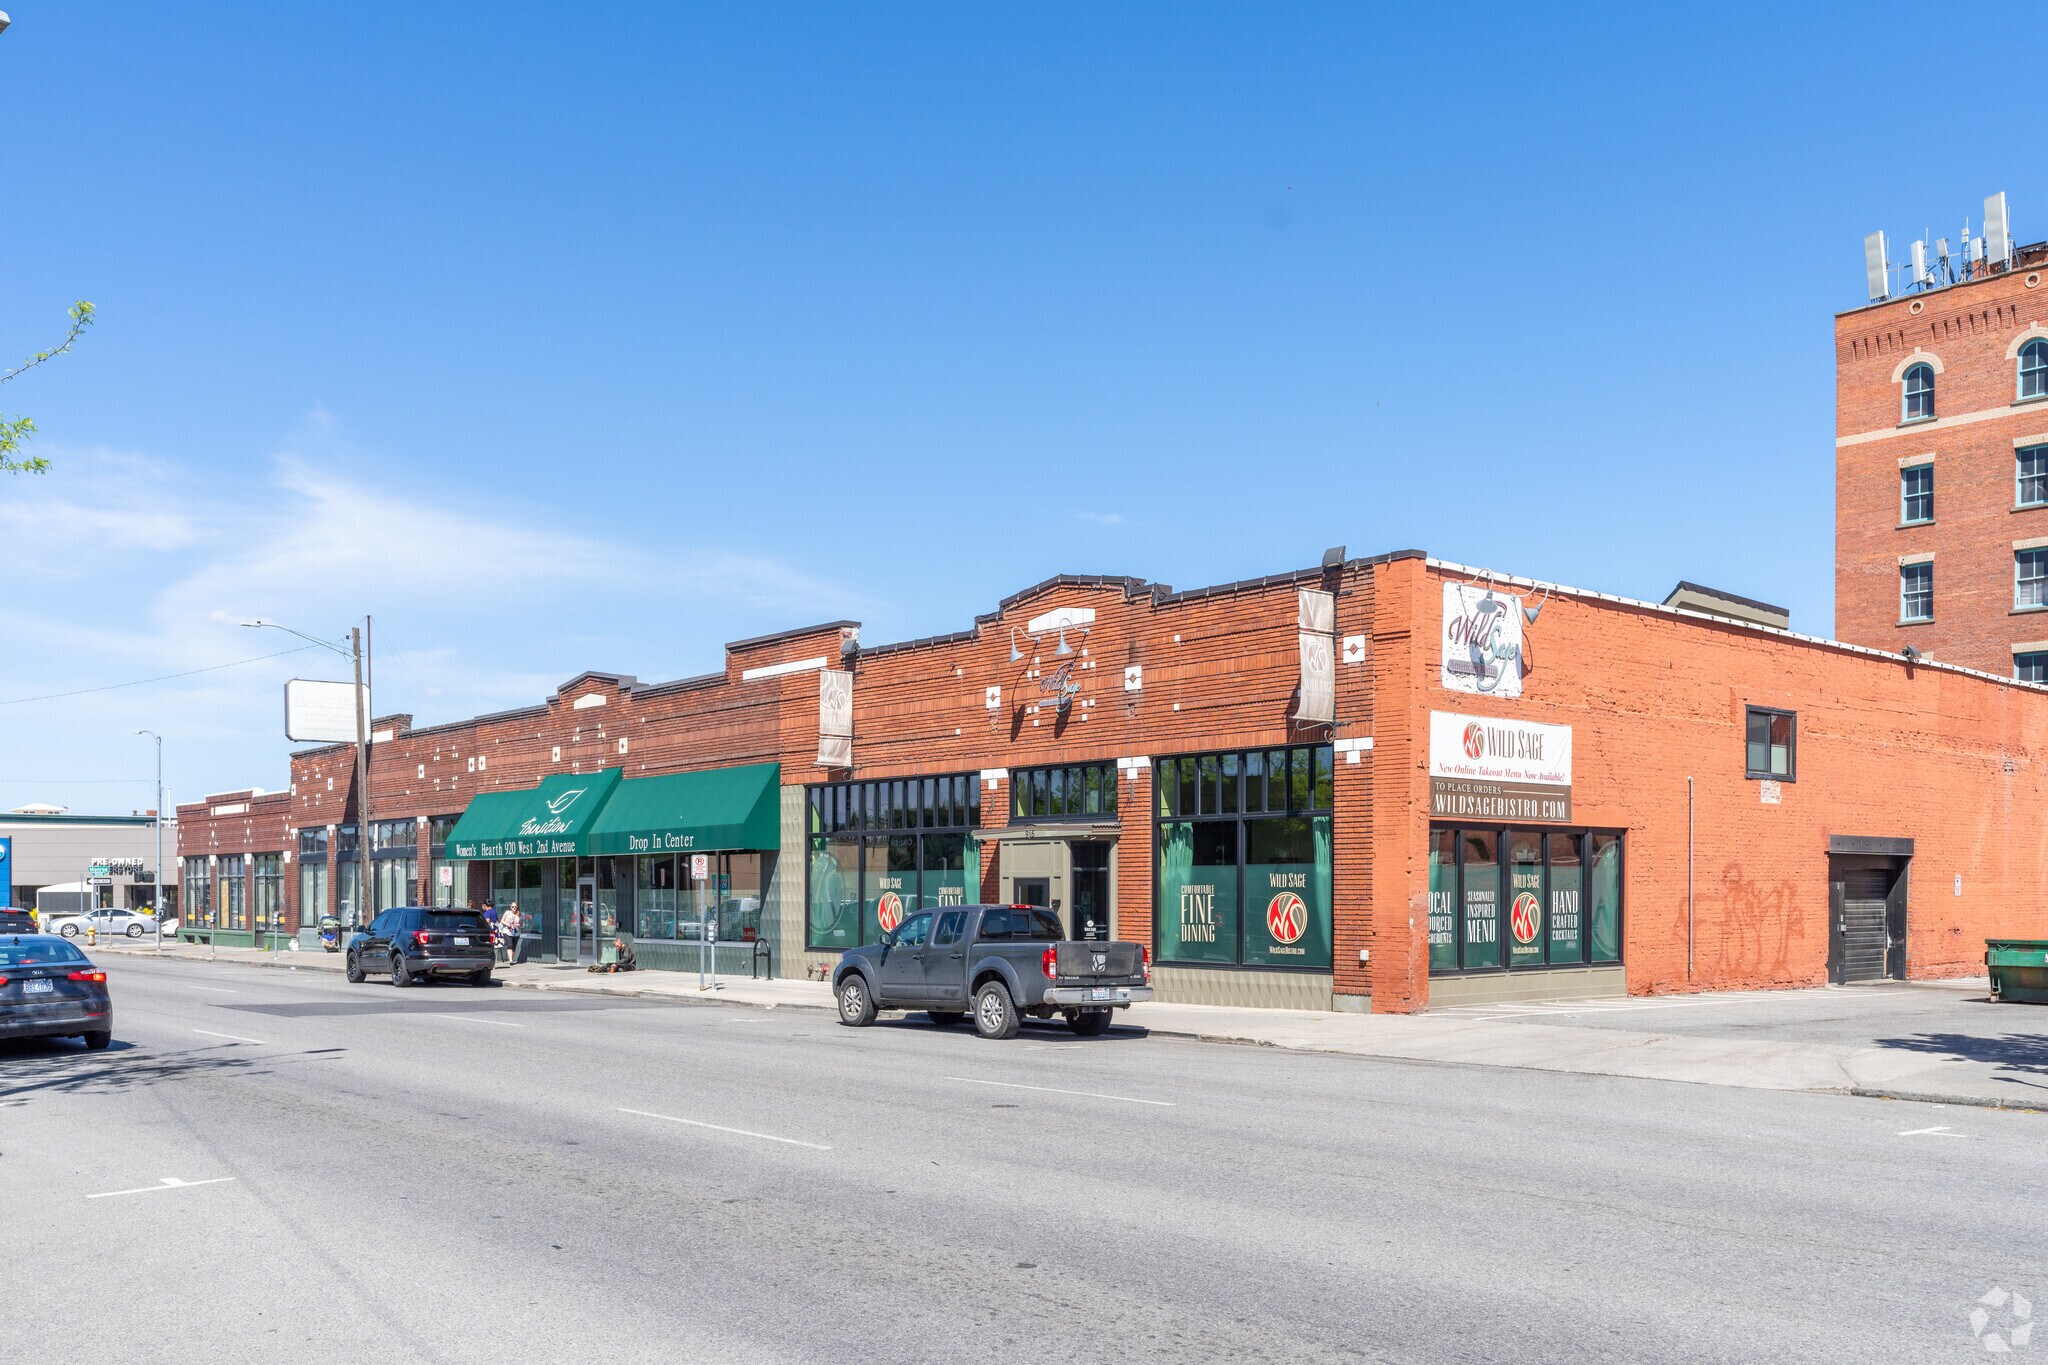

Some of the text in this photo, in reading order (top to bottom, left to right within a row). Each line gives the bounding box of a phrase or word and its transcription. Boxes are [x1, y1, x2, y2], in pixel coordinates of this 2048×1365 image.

[1449, 601, 1507, 651] Wild
[1450, 661, 1497, 675] American Bistro
[1487, 726, 1544, 761] WILD SAGE
[1438, 763, 1565, 782] New Online Takeout Menu Now Available!
[1435, 782, 1502, 794] TO PLACE ORDERS
[1435, 794, 1565, 818] WILDSAGEBISTRO.COM
[456, 840, 576, 857] Women's Hearth 920 West 2nd Avenue
[629, 833, 694, 851] Drop In Center
[91, 857, 143, 866] PRE-OWNED
[109, 866, 143, 875] ERSTORE
[879, 877, 902, 889] WILD SAGE
[1269, 872, 1306, 888] WILD SAGE
[1513, 873, 1540, 889] WILD SAGE
[1181, 885, 1214, 894] COMFORTABLE
[1467, 891, 1495, 902] SEASONALLY
[1181, 894, 1215, 924] FINE
[1428, 891, 1452, 914] OCAL
[1552, 890, 1578, 914] HAND
[1467, 903, 1496, 918] INSPIRED
[1428, 916, 1452, 931] OURCED
[1552, 914, 1578, 929] CRAFTED
[1181, 924, 1215, 942] DINING
[1467, 919, 1496, 943] MENU
[1552, 929, 1578, 941] COCKTAILS
